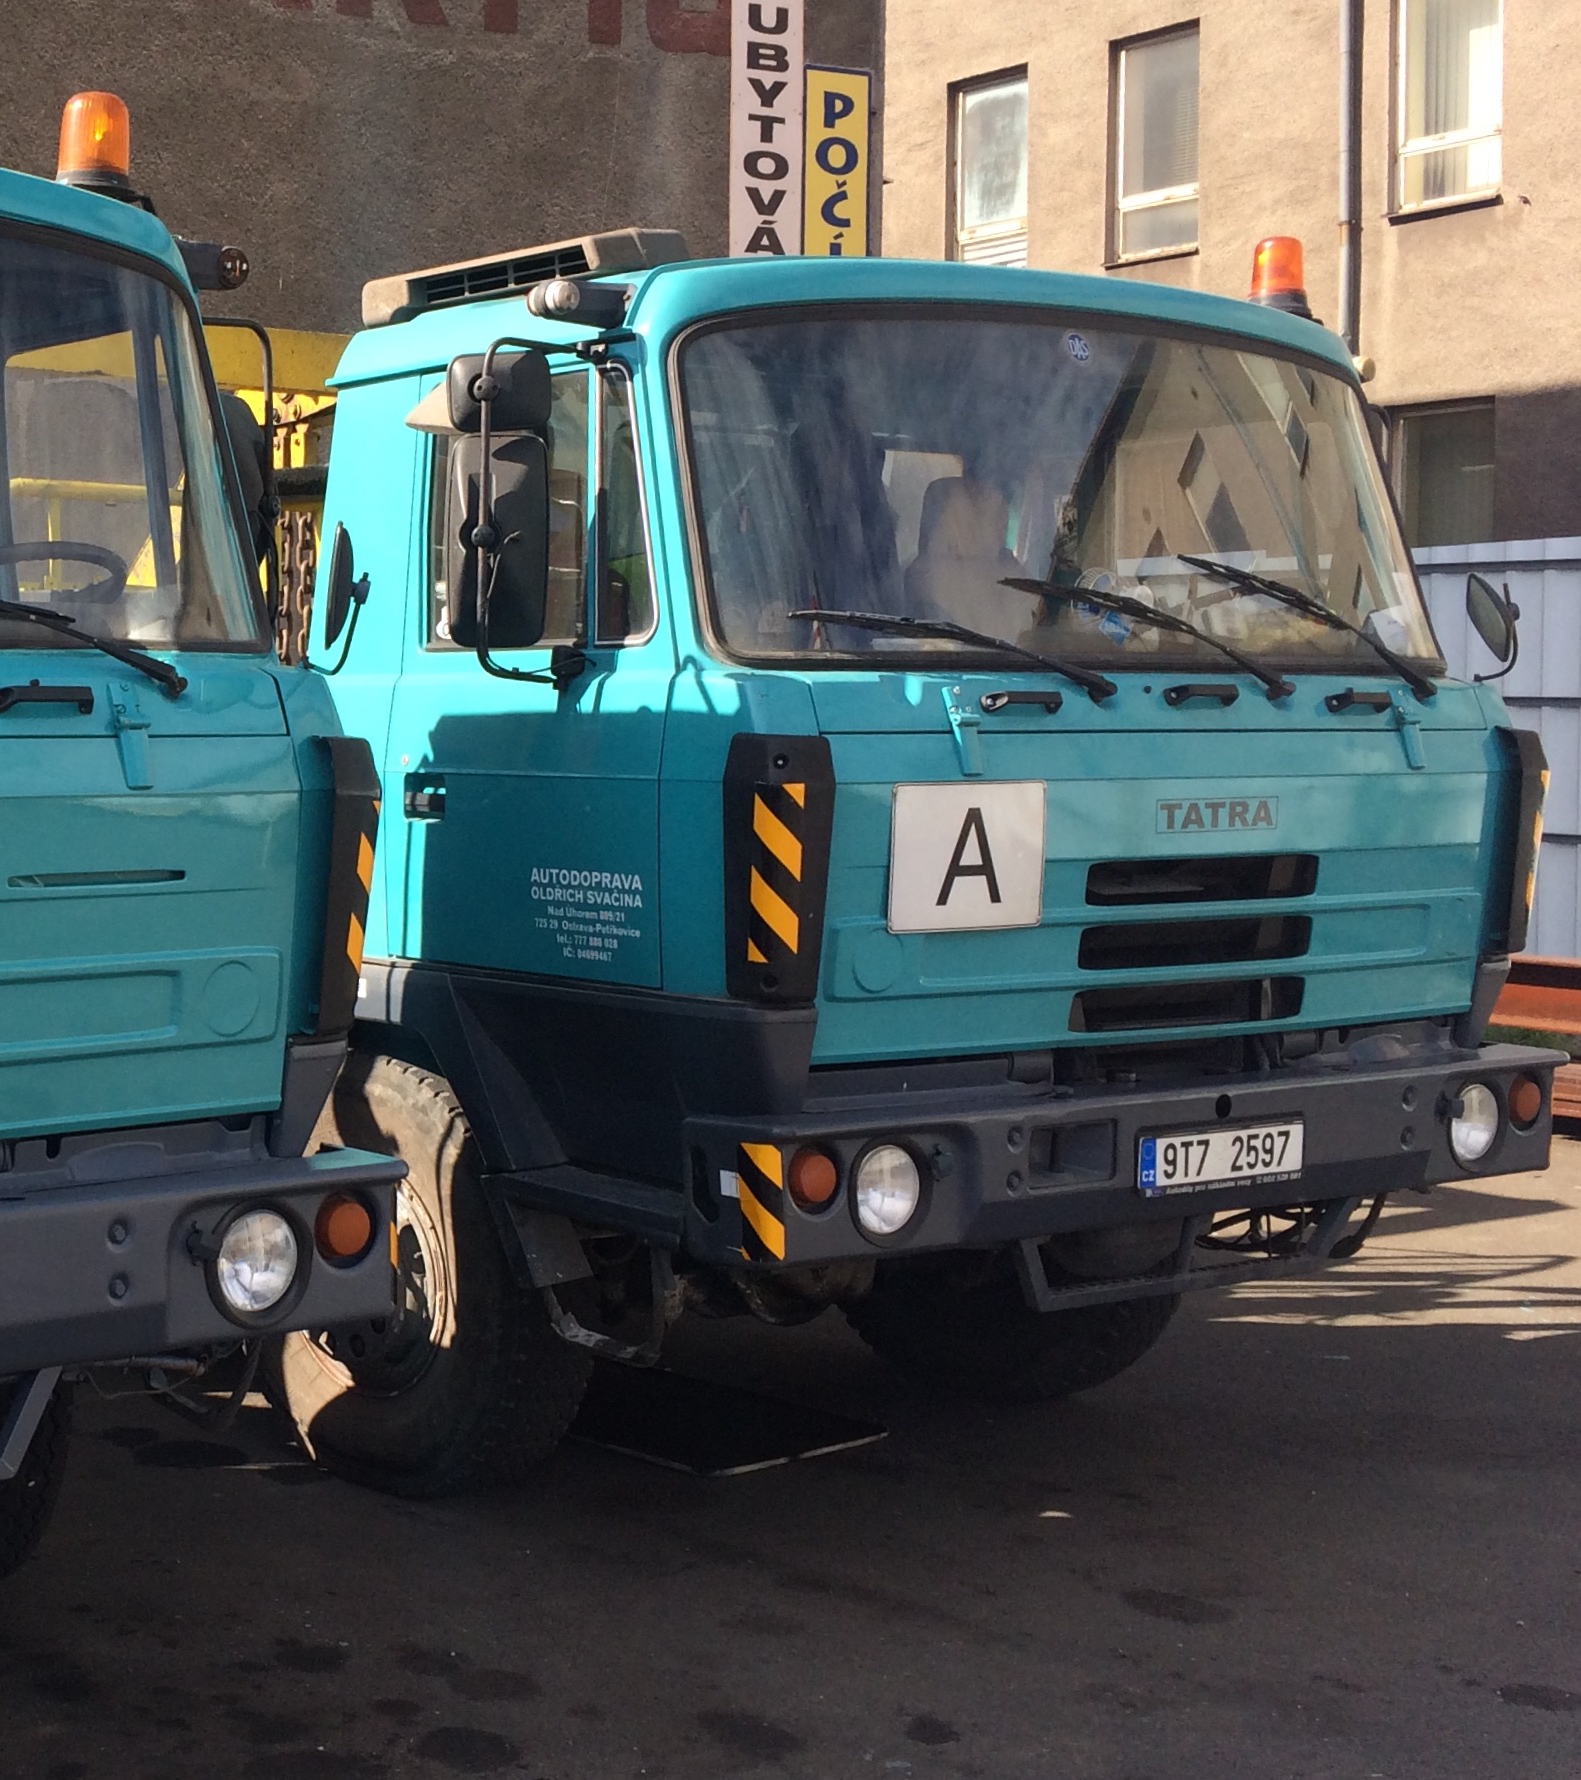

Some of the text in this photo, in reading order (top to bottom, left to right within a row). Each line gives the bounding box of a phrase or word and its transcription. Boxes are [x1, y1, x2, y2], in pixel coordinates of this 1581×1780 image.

[743, 3, 789, 255] UBYTOVÁ
[1159, 799, 1274, 830] TATRA
[935, 806, 1002, 906] A
[530, 867, 643, 891] AUTODOPRAVA
[530, 885, 643, 908] OLDŘICH SVAČINA
[547, 905, 564, 917] Nad
[1163, 1130, 1291, 1179] 9T7 2597
[1142, 1170, 1155, 1182] CZ
